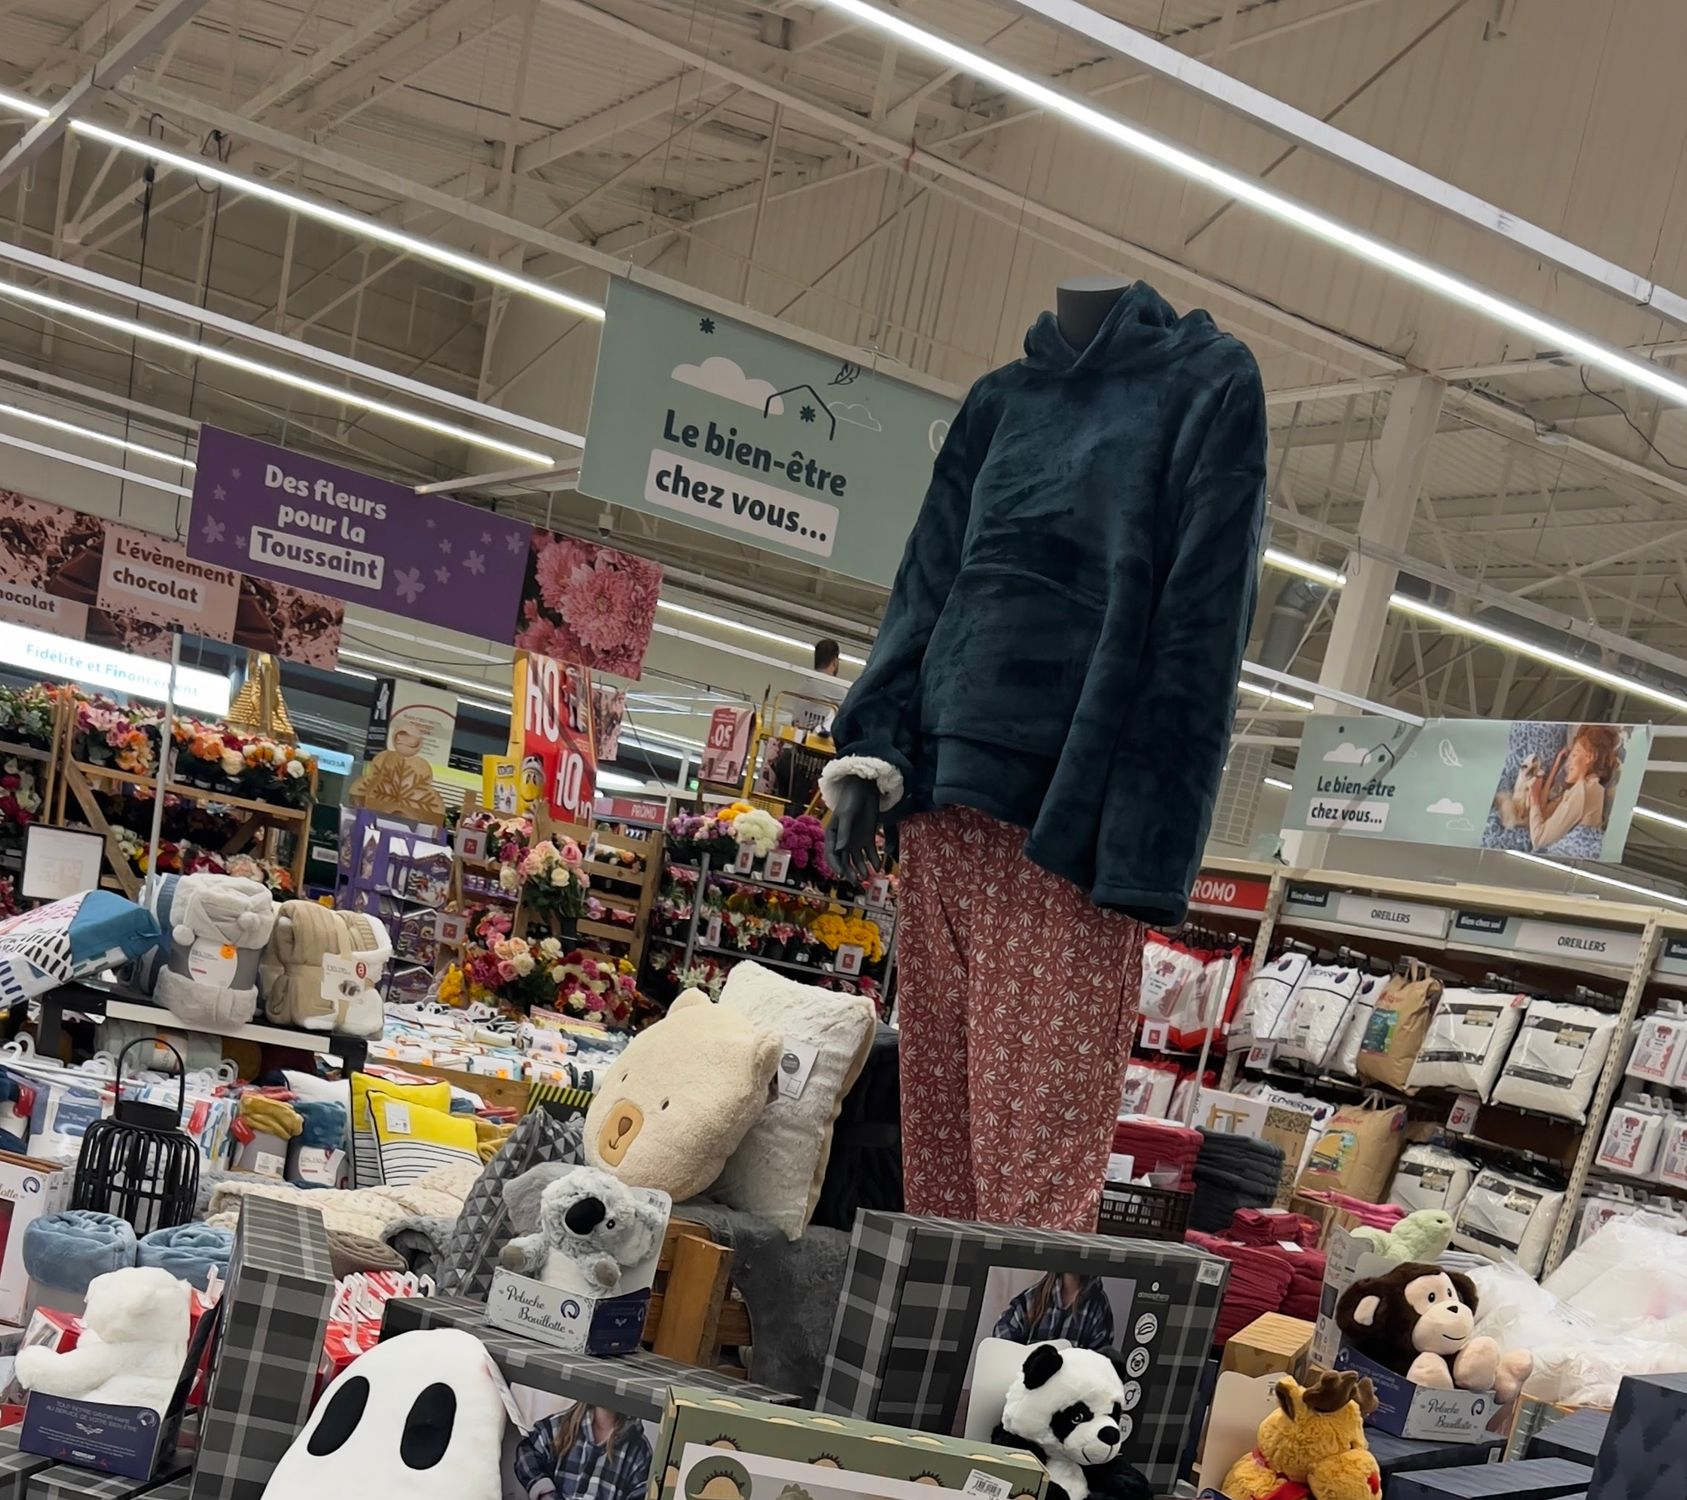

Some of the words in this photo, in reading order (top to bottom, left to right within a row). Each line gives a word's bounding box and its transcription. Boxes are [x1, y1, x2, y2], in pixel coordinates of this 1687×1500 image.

[663, 409, 697, 448] Le
[705, 421, 847, 496] bien-être
[265, 464, 309, 497] Des
[314, 479, 387, 520] fleurs
[655, 464, 724, 509] chez
[732, 492, 827, 543] vous...
[278, 504, 336, 535] pour
[341, 516, 366, 544] la
[116, 537, 235, 587] L'évènement
[257, 531, 378, 580] Toussaint
[113, 567, 198, 604] chocolat
[26, 644, 83, 668] Fidélité
[87, 661, 101, 674] et
[1317, 776, 1332, 793] Le
[1333, 776, 1396, 797] bien-être
[631, 803, 656, 819] PROMO
[1311, 802, 1339, 820] chez
[1341, 808, 1382, 823] vous...
[1191, 879, 1236, 902] ROMO
[1371, 909, 1410, 924] OREILLERS
[1558, 936, 1606, 952] OREILLERS
[507, 1285, 545, 1309] Peluche
[518, 1307, 566, 1333] Bouillotte
